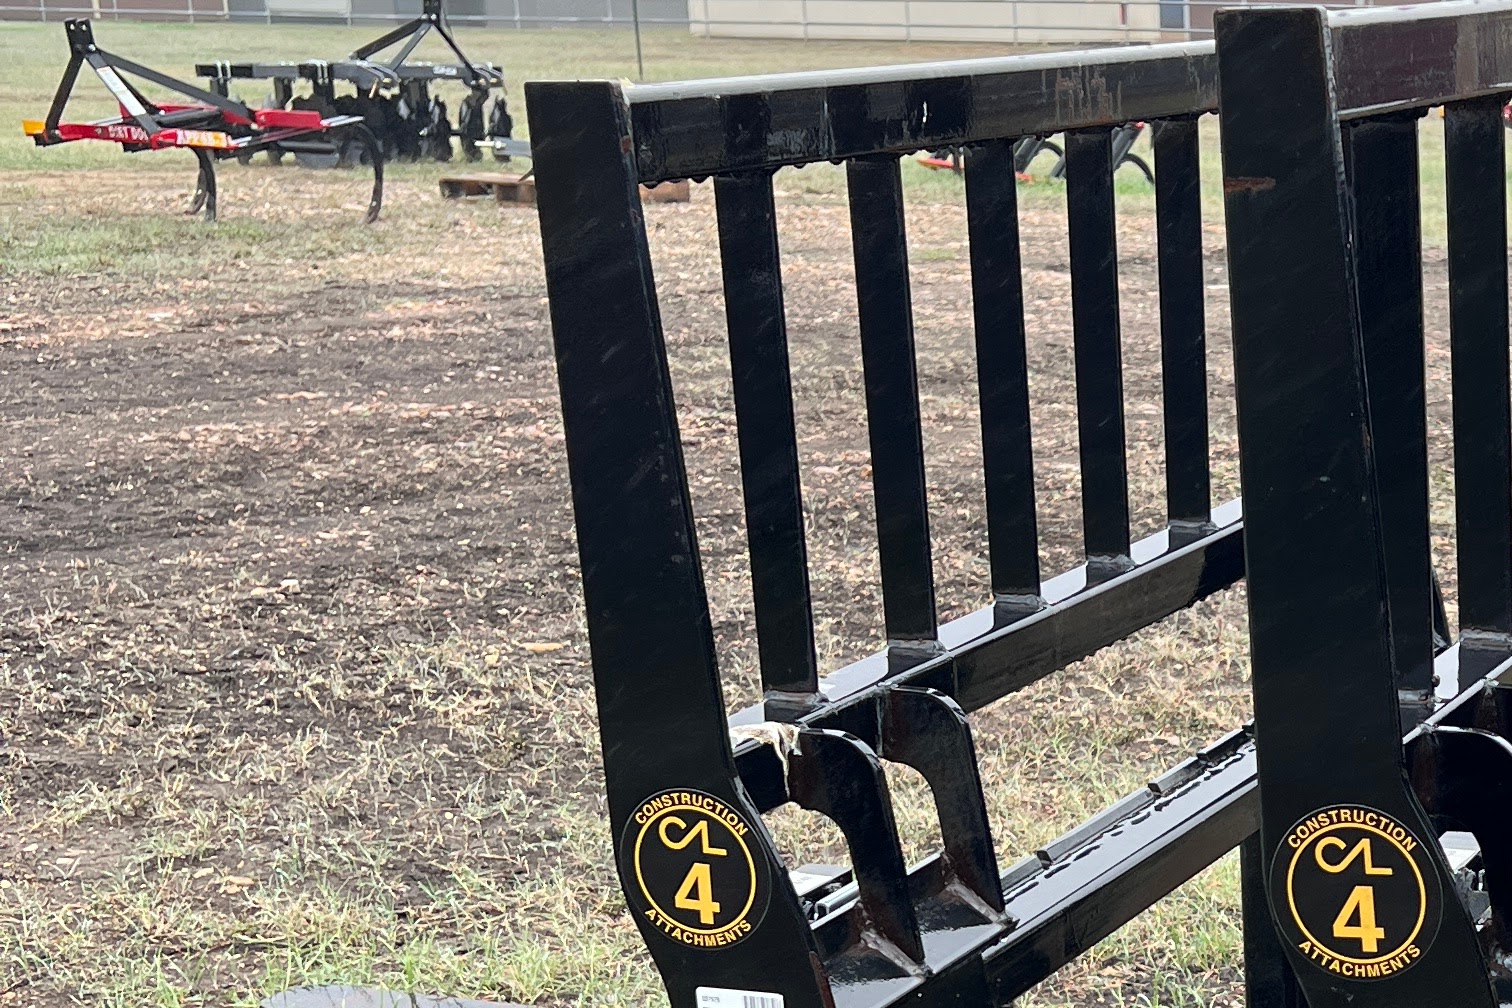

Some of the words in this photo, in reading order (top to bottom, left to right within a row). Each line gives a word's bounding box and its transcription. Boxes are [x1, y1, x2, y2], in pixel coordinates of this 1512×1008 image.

[635, 792, 748, 836] CONSTRUCTION
[1288, 809, 1417, 852] CONSTRUCTION
[674, 862, 721, 925] 4
[644, 909, 752, 947] ATTACHMENTS
[1332, 885, 1385, 953] 4
[1298, 940, 1421, 978] ATTACHMENTS
